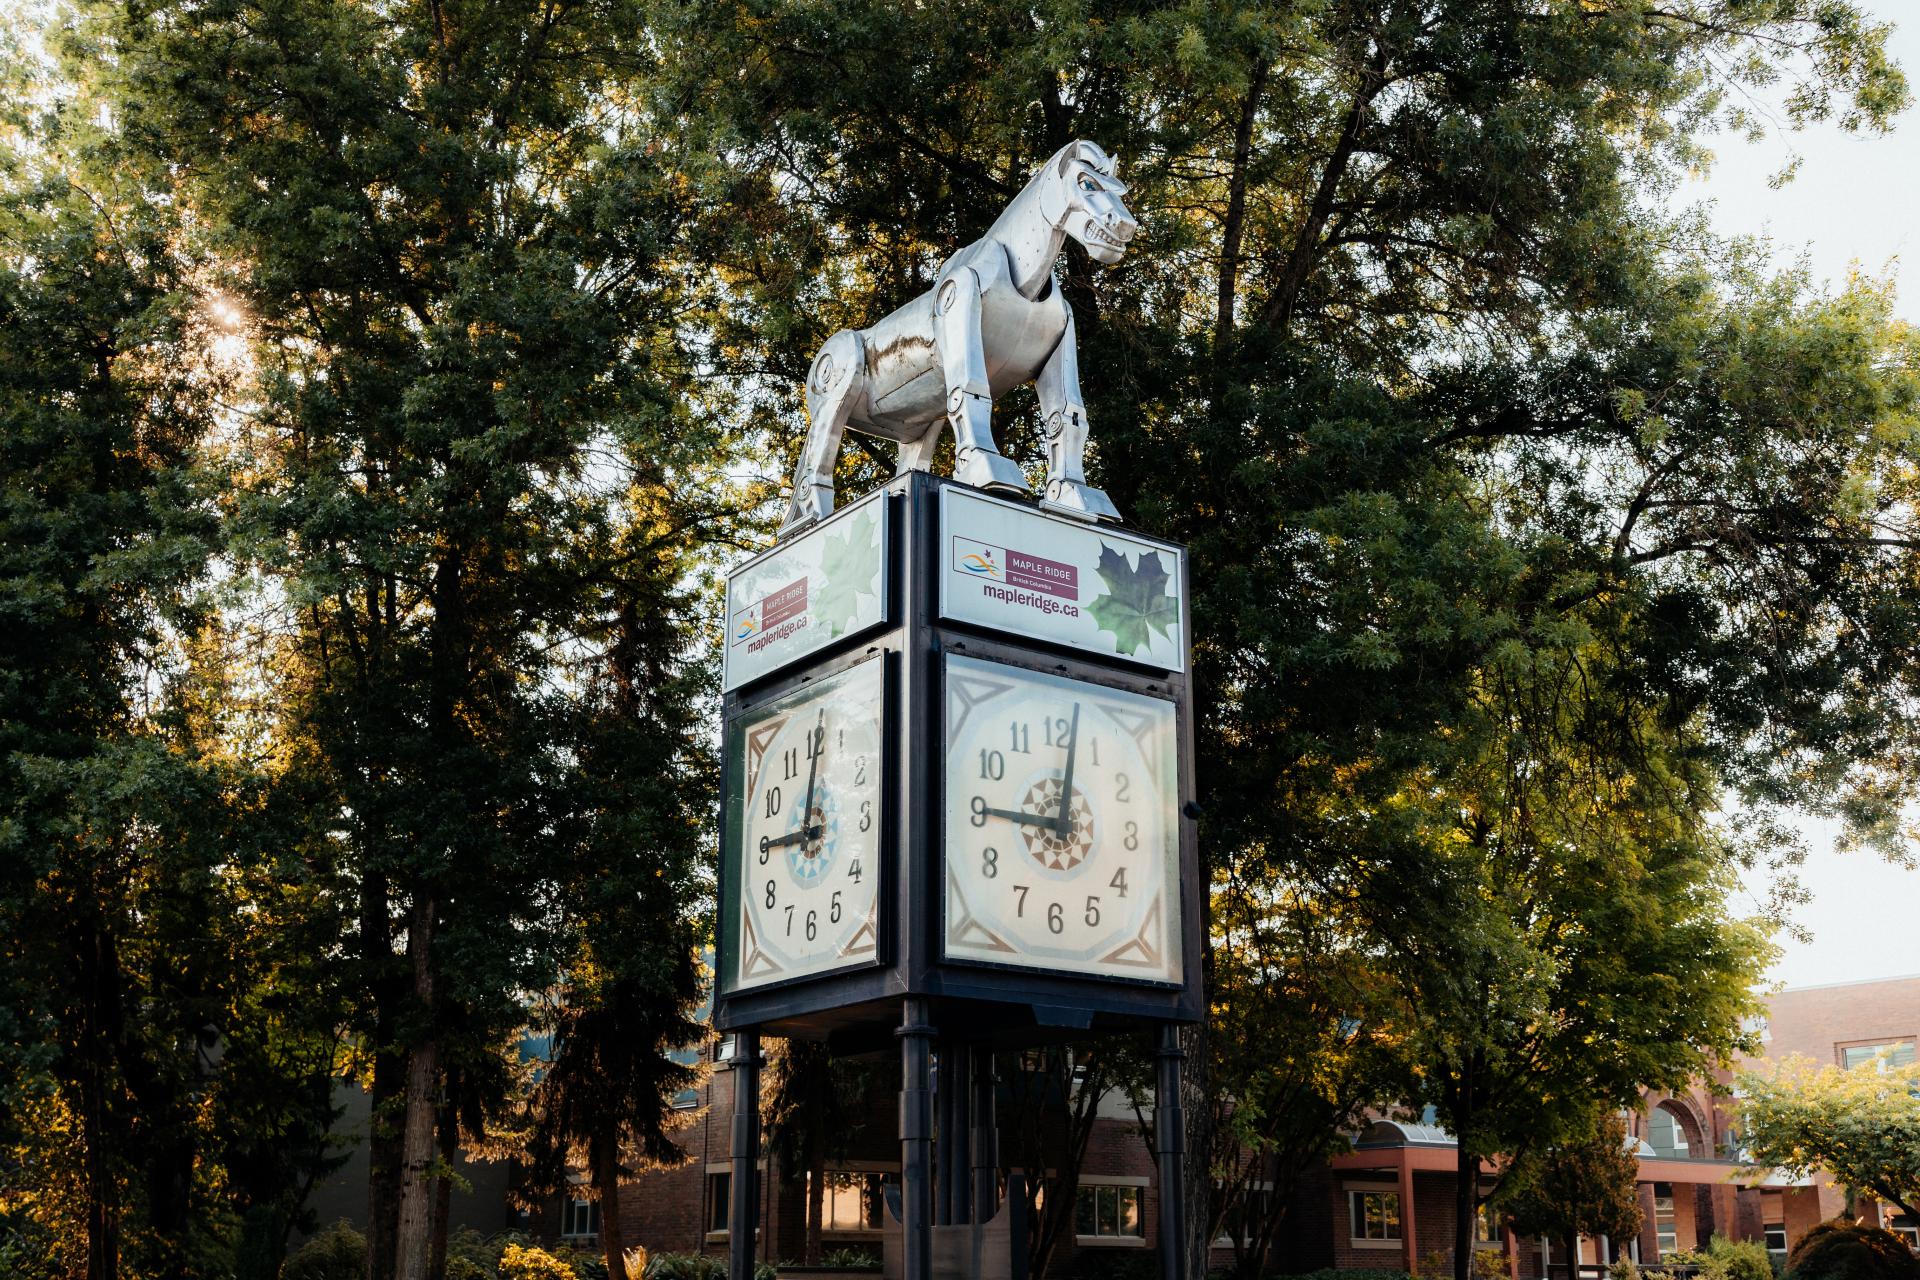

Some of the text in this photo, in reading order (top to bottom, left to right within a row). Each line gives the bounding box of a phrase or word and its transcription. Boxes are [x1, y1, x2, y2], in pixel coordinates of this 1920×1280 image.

[1012, 558, 1071, 581] MAPLE RIDGE
[767, 586, 803, 610] MAPLE RIDGE
[983, 584, 1079, 618] mapleridge.ca
[747, 616, 807, 654] mapleridge.ca
[1010, 721, 1031, 754] 11
[1043, 716, 1072, 749] 12
[784, 748, 798, 780] 11
[979, 748, 1005, 781] 10
[1090, 737, 1101, 766] 1
[854, 756, 866, 787] 2
[765, 787, 781, 819] 10
[1115, 772, 1130, 803] 2
[859, 800, 871, 832] 3
[970, 796, 987, 828] 9
[759, 836, 770, 865] 9
[1123, 821, 1138, 851] 3
[847, 857, 862, 884] 4
[982, 847, 998, 879] 8
[765, 880, 776, 909] 8
[1109, 867, 1128, 898] 4
[830, 891, 842, 923] 5
[1013, 885, 1029, 918] 7
[1084, 896, 1100, 927] 5
[784, 905, 795, 936] 7
[806, 910, 817, 941] 6
[1047, 903, 1064, 934] 6
